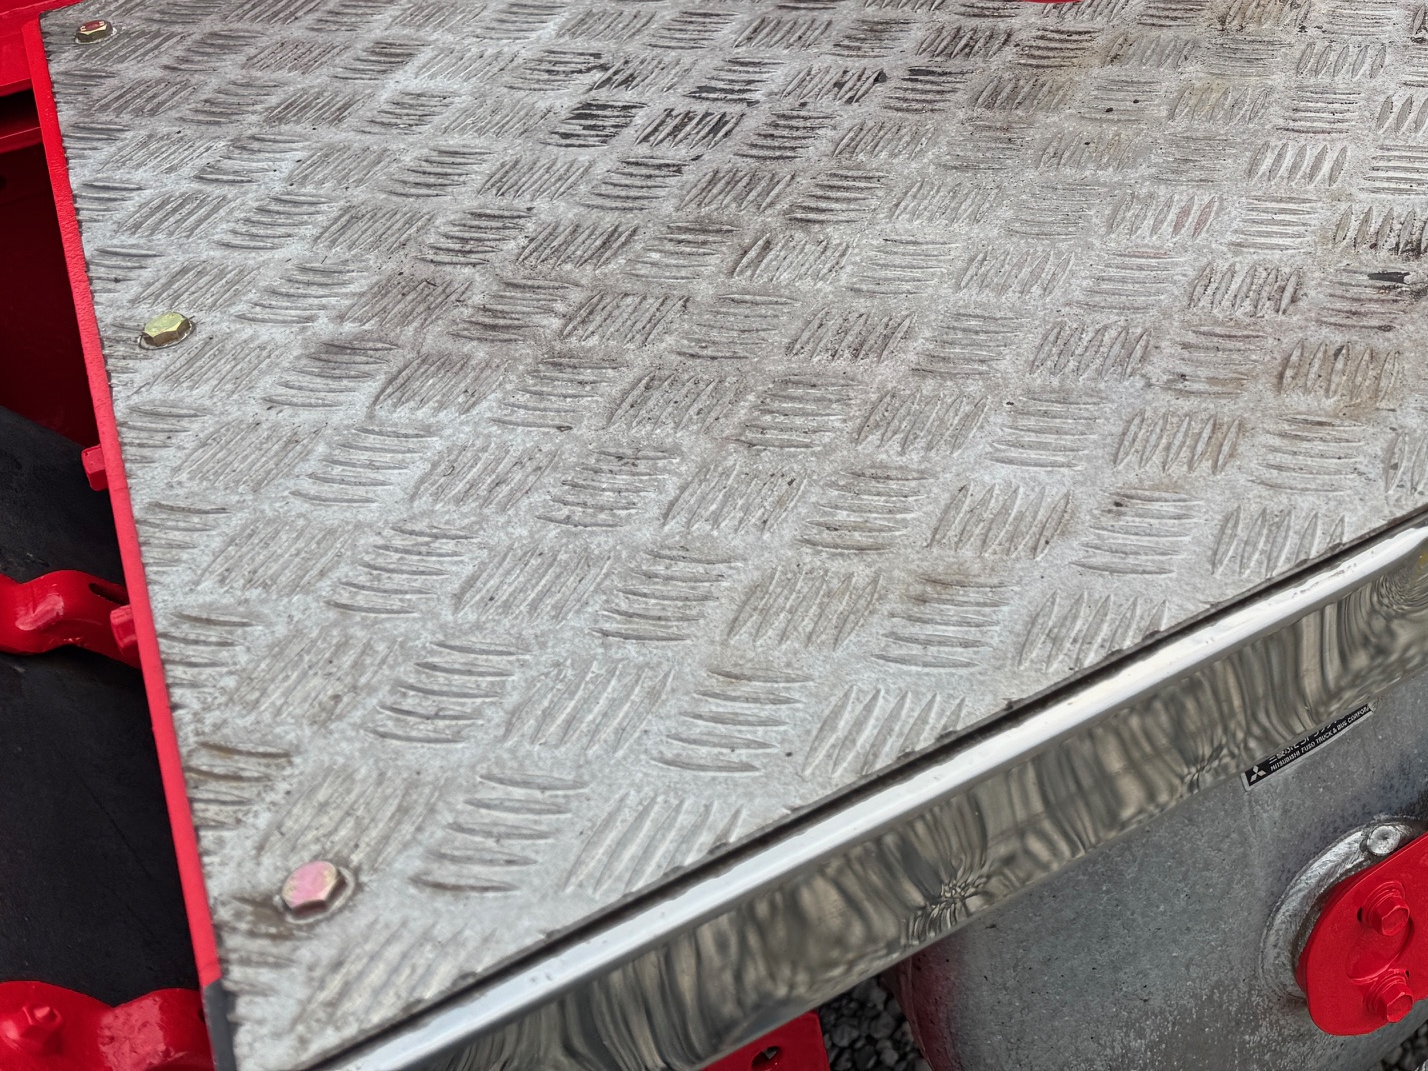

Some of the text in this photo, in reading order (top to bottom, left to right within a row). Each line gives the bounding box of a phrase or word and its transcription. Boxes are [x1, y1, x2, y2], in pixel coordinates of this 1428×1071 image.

[1270, 750, 1301, 772] MITSUBISHI
[1301, 741, 1316, 753] FUSO
[1315, 731, 1334, 745] TRUCK
[1337, 719, 1348, 731] BUS
